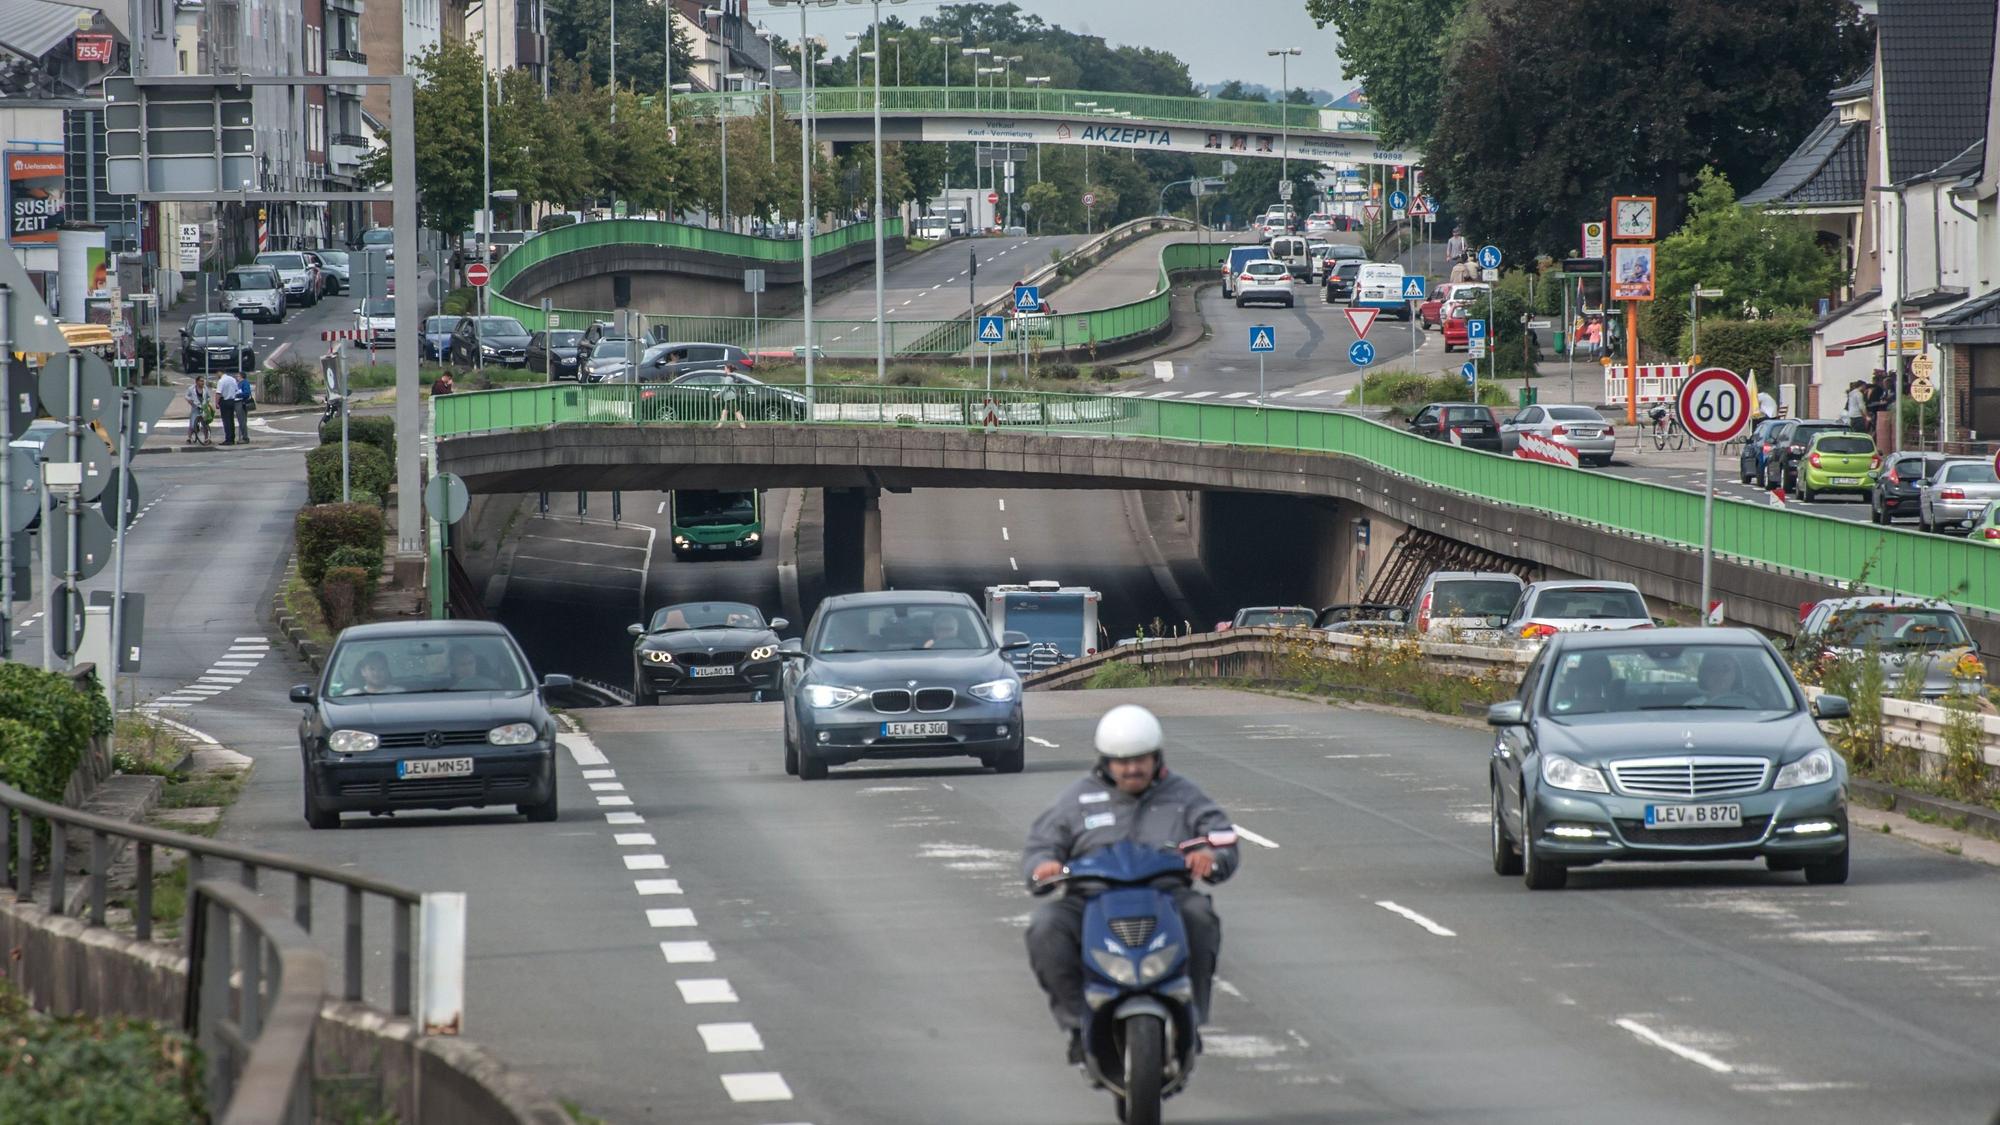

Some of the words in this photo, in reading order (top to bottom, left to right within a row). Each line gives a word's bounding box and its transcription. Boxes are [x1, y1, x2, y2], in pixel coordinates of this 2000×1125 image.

[985, 121, 1015, 129] Verkauf
[990, 130, 1033, 138] Vermietung
[1081, 126, 1171, 146] AKZEPTA
[1373, 152, 1403, 160] 949898
[15, 200, 60, 215] SUSHI
[15, 216, 48, 232] ZEIT
[1472, 323, 1482, 337] P
[1891, 328, 1921, 336] KOSK
[1696, 390, 1735, 423] 60
[887, 724, 907, 735] LEV
[913, 723, 926, 735] ER
[405, 762, 430, 775] LEV
[437, 761, 454, 773] MN
[456, 759, 471, 772] 51
[1656, 807, 1686, 822] LEV
[1696, 807, 1706, 821] B
[1710, 806, 1739, 821] 870
